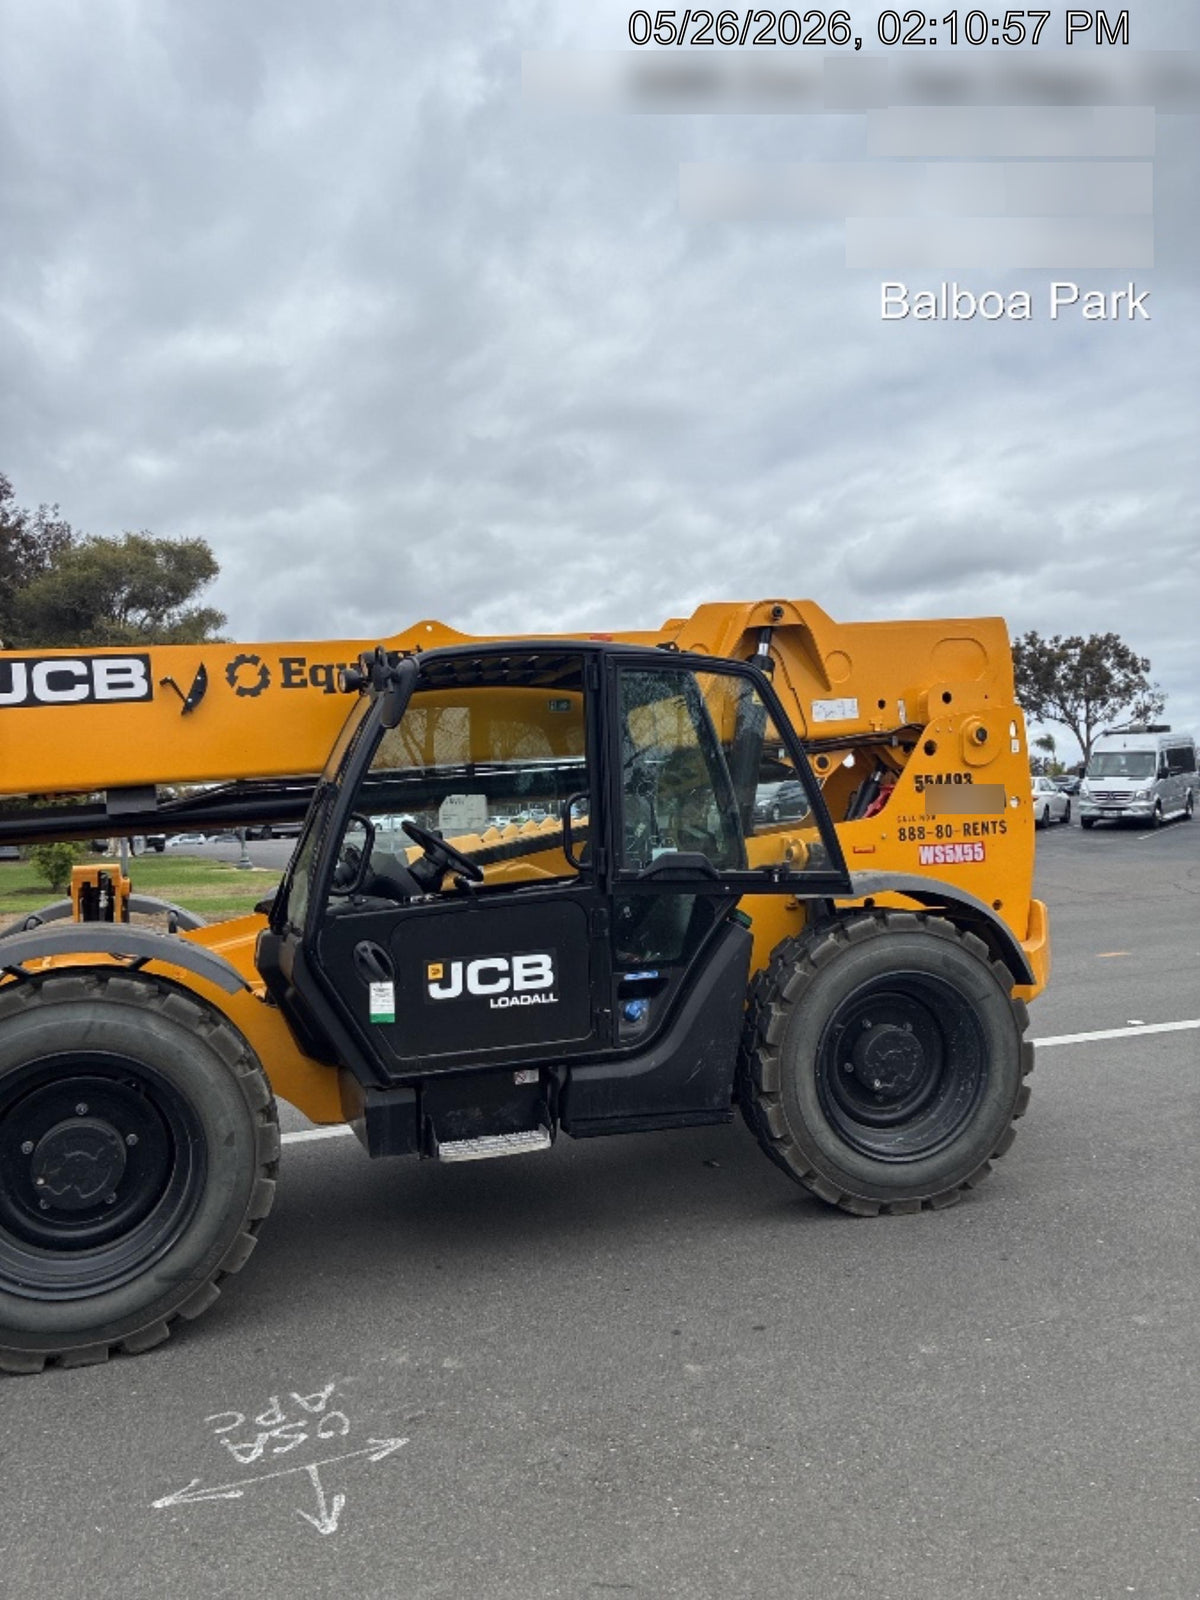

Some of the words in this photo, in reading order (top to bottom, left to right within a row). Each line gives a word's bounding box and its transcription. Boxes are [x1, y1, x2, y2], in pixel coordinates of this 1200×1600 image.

[0, 658, 149, 704] JCB
[428, 954, 554, 999] JCB
[490, 993, 558, 1009] LOADALL
